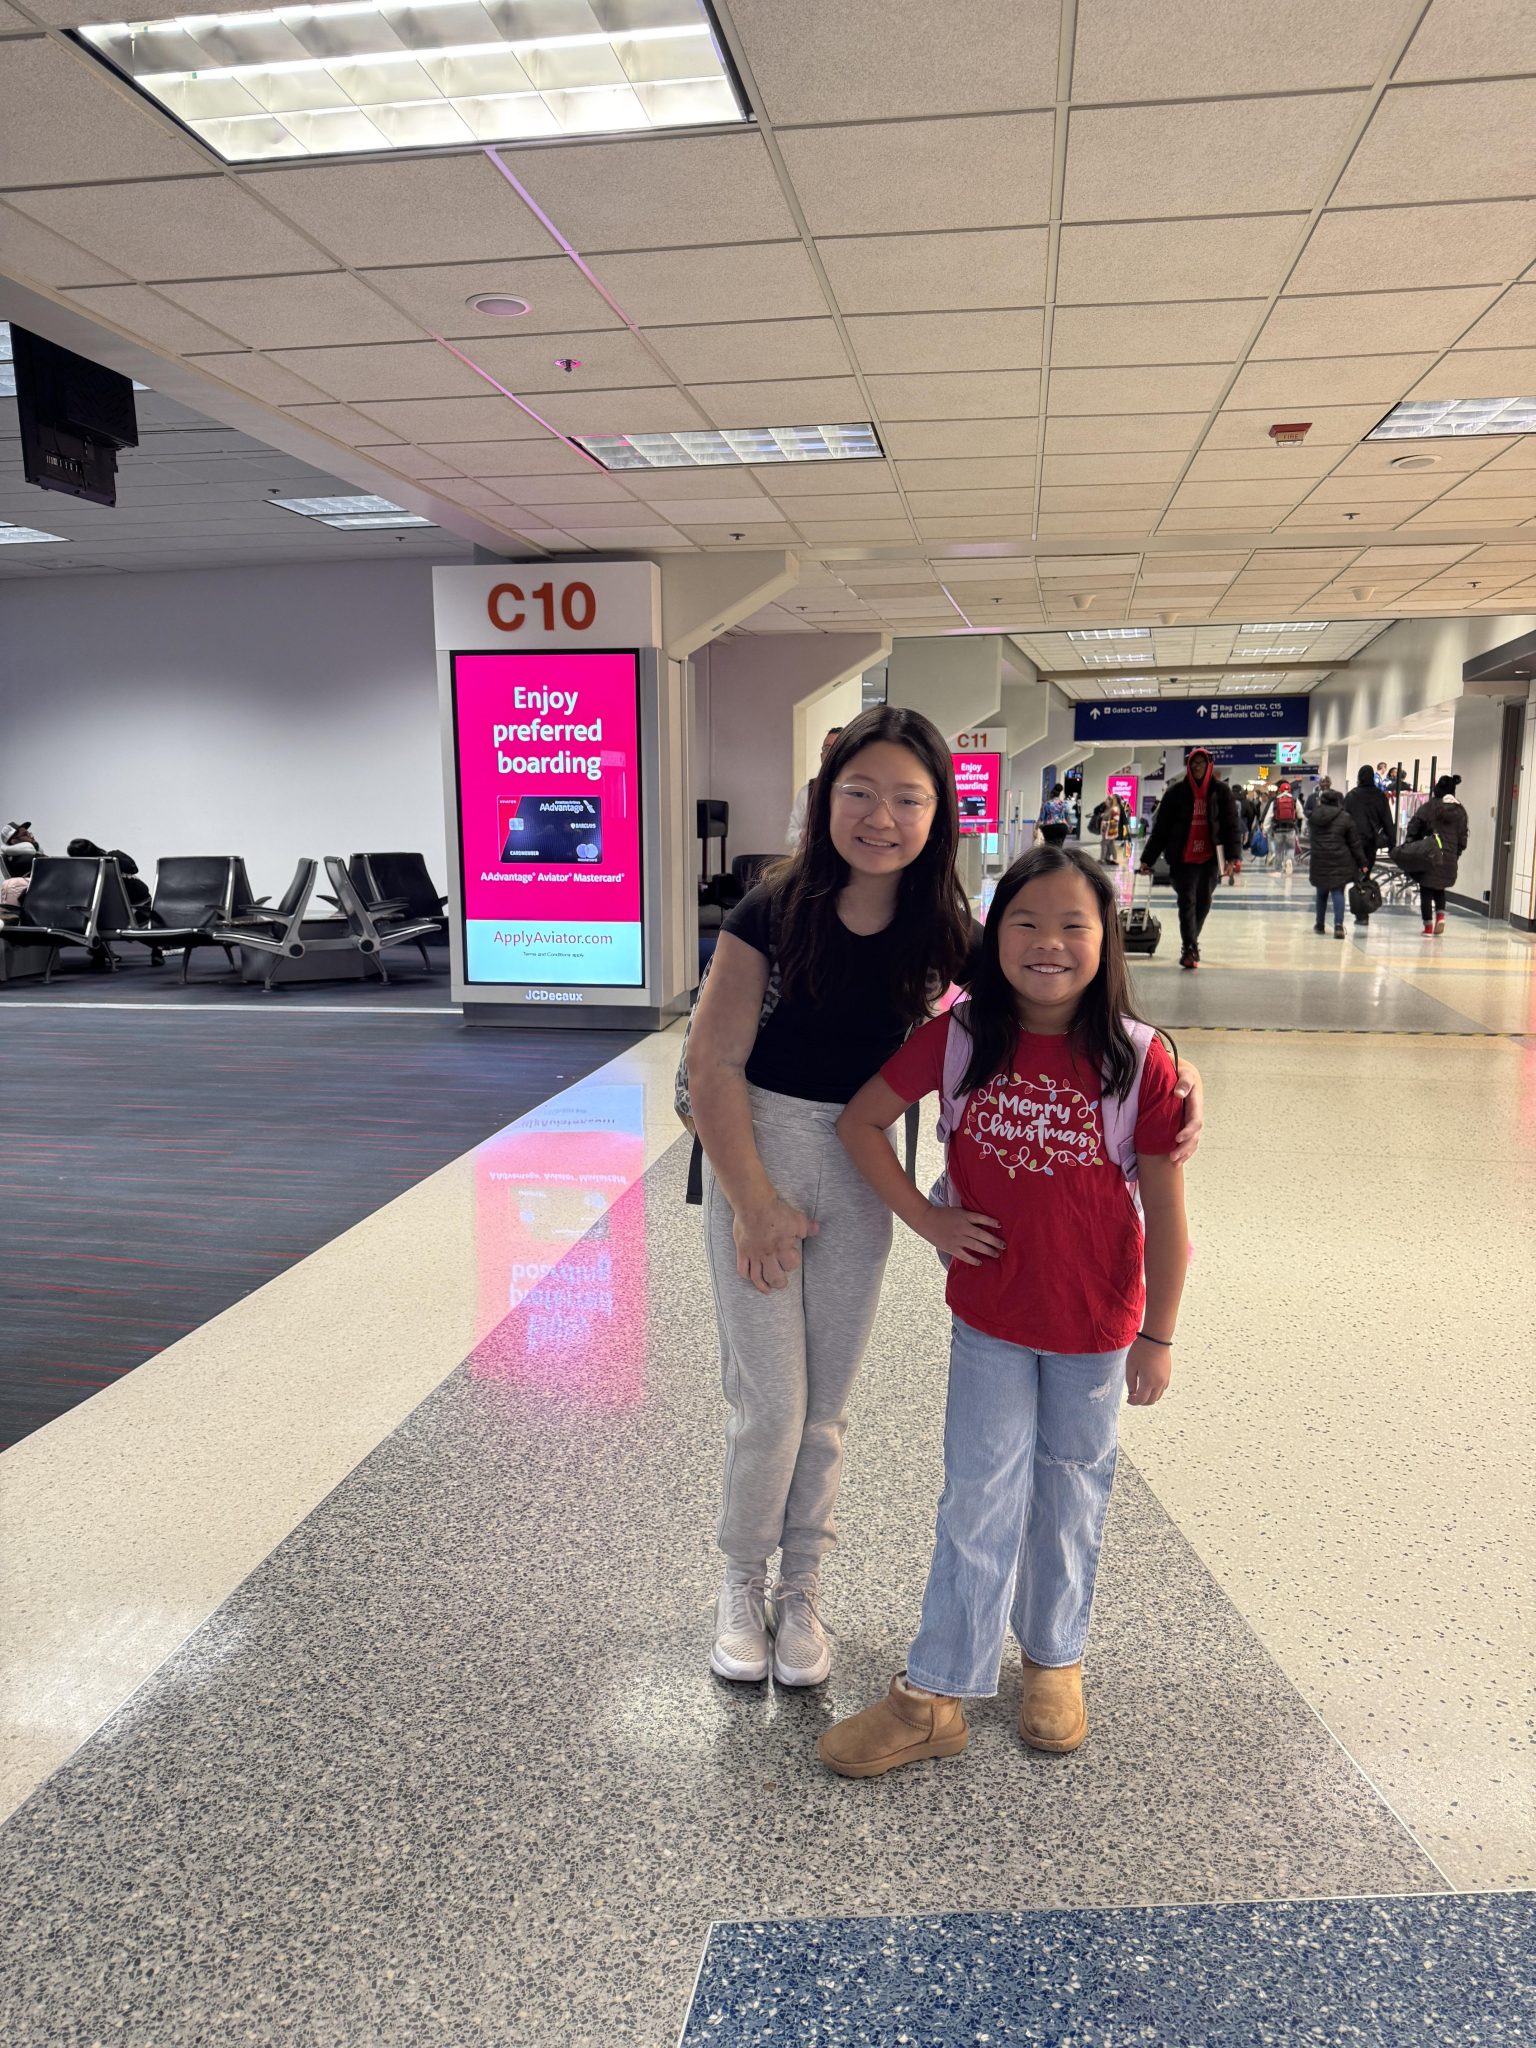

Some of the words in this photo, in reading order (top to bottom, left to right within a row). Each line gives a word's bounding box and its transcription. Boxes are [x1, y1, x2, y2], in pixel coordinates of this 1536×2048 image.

[487, 581, 596, 632] C10
[513, 685, 579, 716] Enjoy
[1219, 704, 1233, 713] Bag
[1234, 703, 1253, 711] Claim
[493, 717, 602, 748] preferred
[956, 733, 988, 749] C11
[497, 750, 602, 780] boarding
[960, 762, 983, 773] Enjoy
[539, 802, 584, 814] AAdvantage
[493, 930, 613, 947] ApplyAviator.com
[525, 989, 583, 1001] JCDecaux
[998, 1091, 1071, 1125] Merry
[978, 1112, 1091, 1149] Christmas
